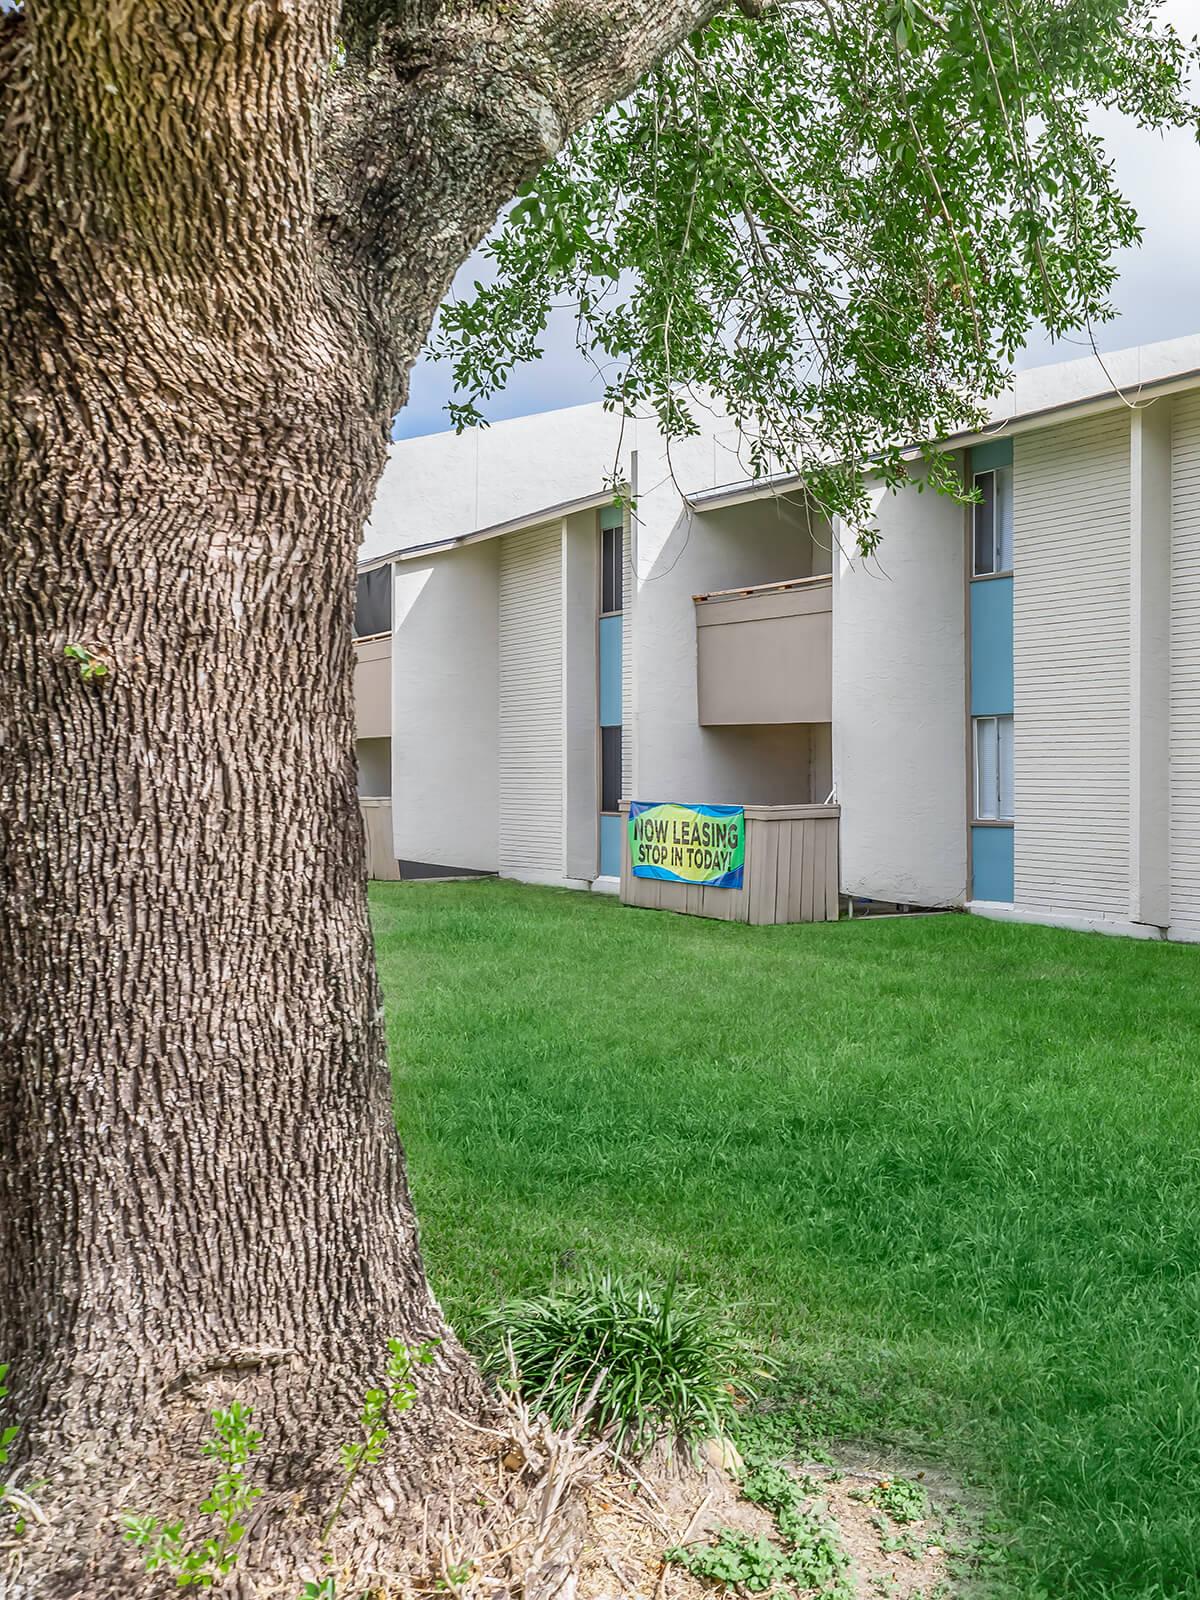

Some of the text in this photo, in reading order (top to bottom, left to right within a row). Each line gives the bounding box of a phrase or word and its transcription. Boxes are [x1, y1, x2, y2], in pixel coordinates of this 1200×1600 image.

[634, 818, 738, 849] NOW LEASING
[638, 843, 732, 872] STOP IN TODAY!
